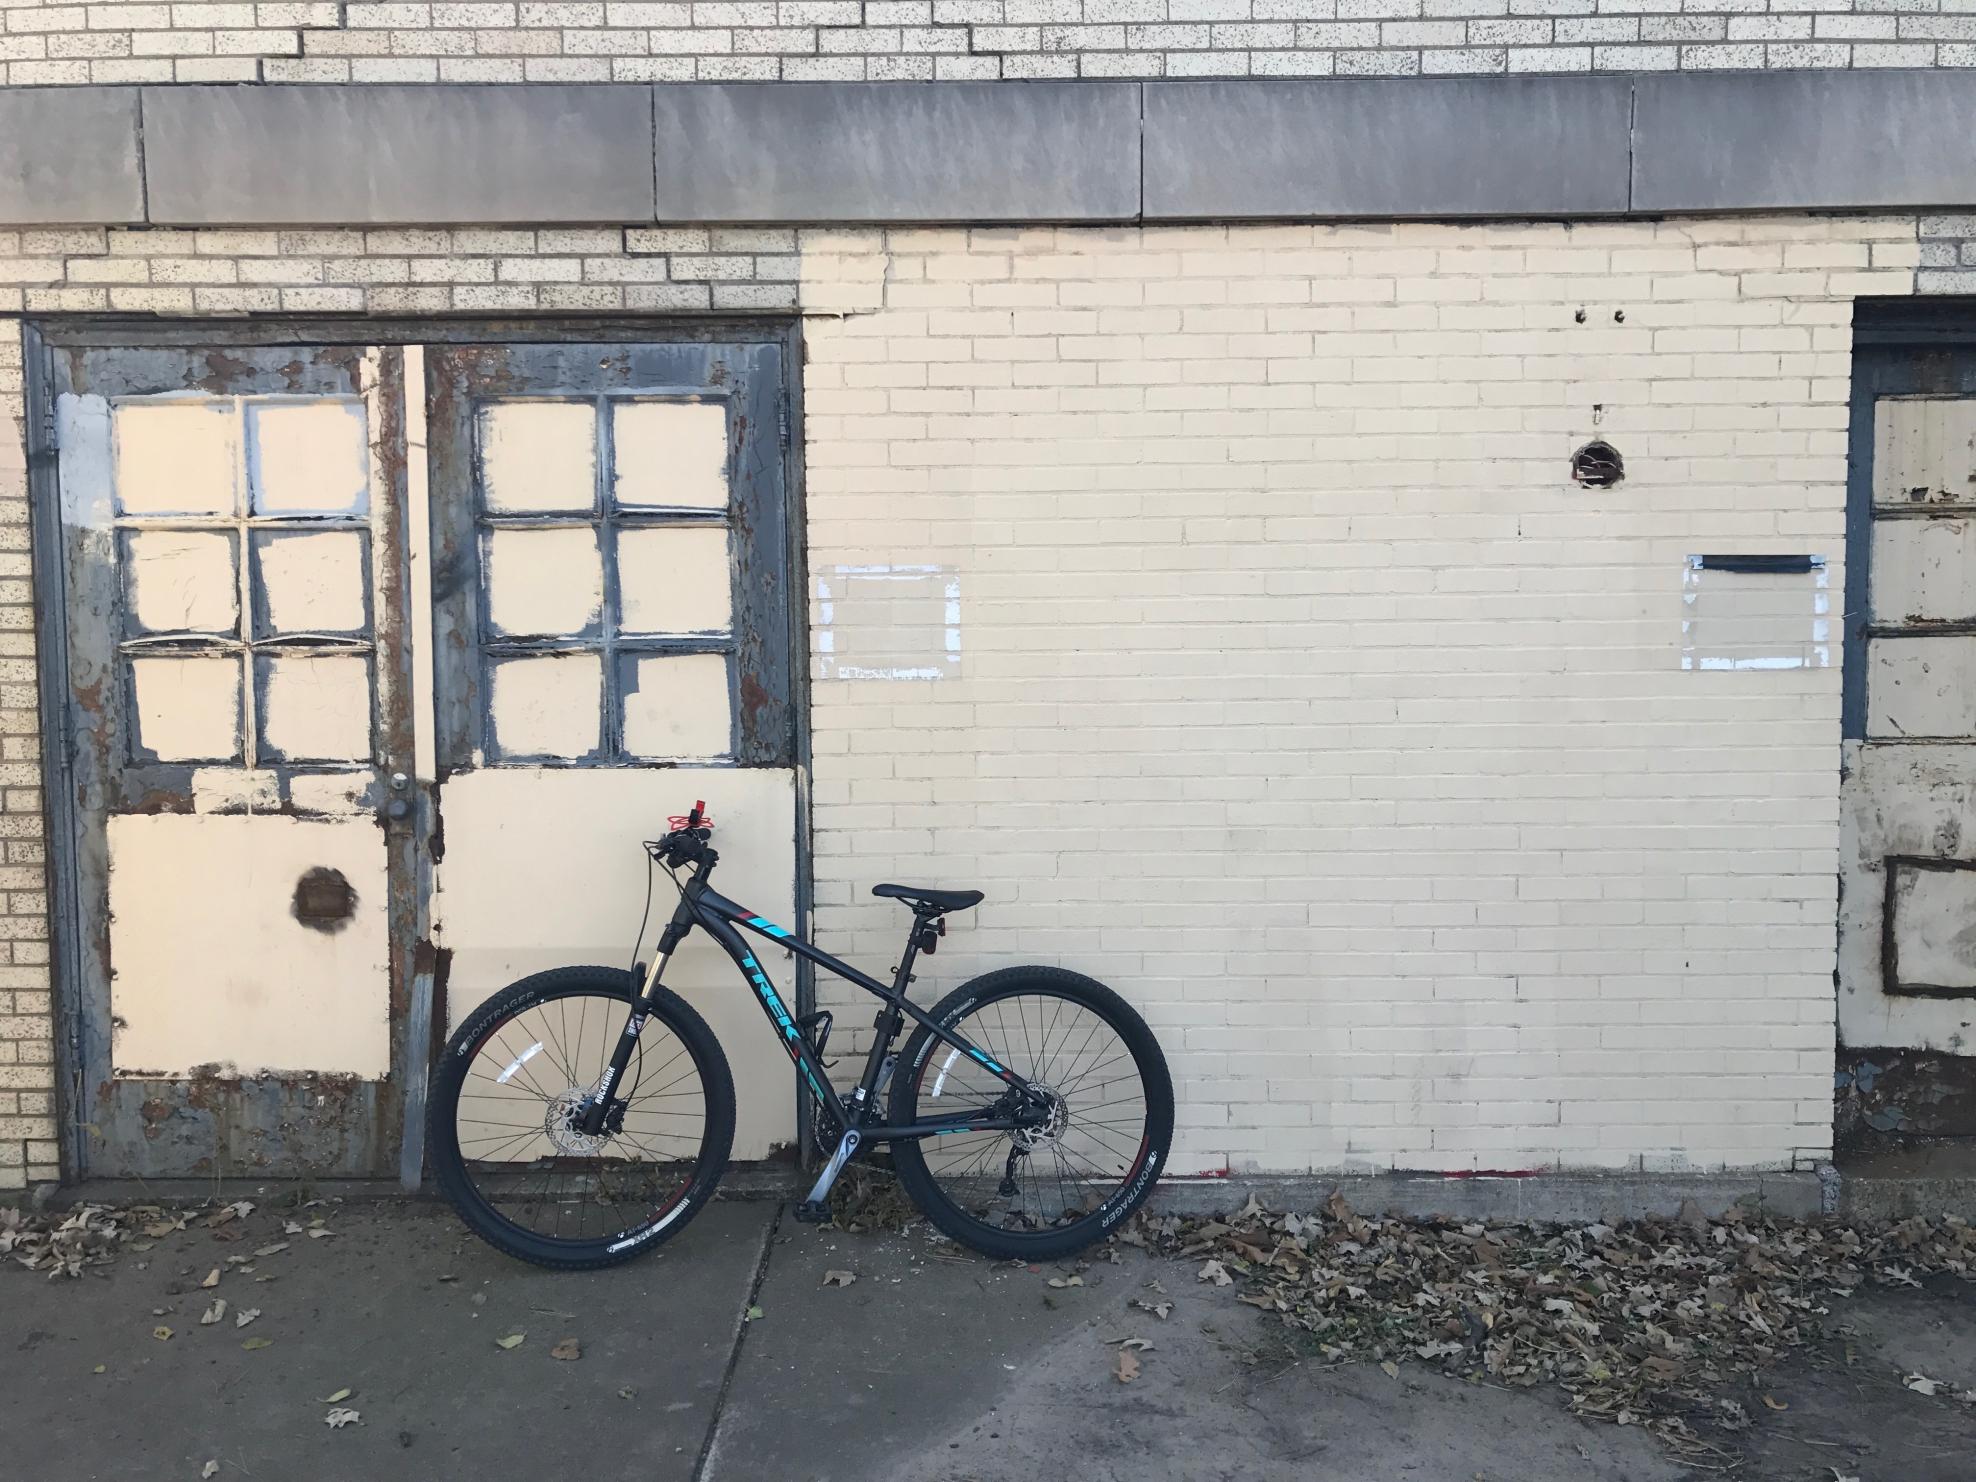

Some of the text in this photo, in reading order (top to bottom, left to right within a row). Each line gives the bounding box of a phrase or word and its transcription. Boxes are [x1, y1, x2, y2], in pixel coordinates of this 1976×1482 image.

[465, 991, 535, 1046] BONTRAGER
[742, 949, 801, 1042] TREK
[594, 1065, 616, 1105] ROCKSHOX
[1101, 1162, 1153, 1228] BONTRAGER
